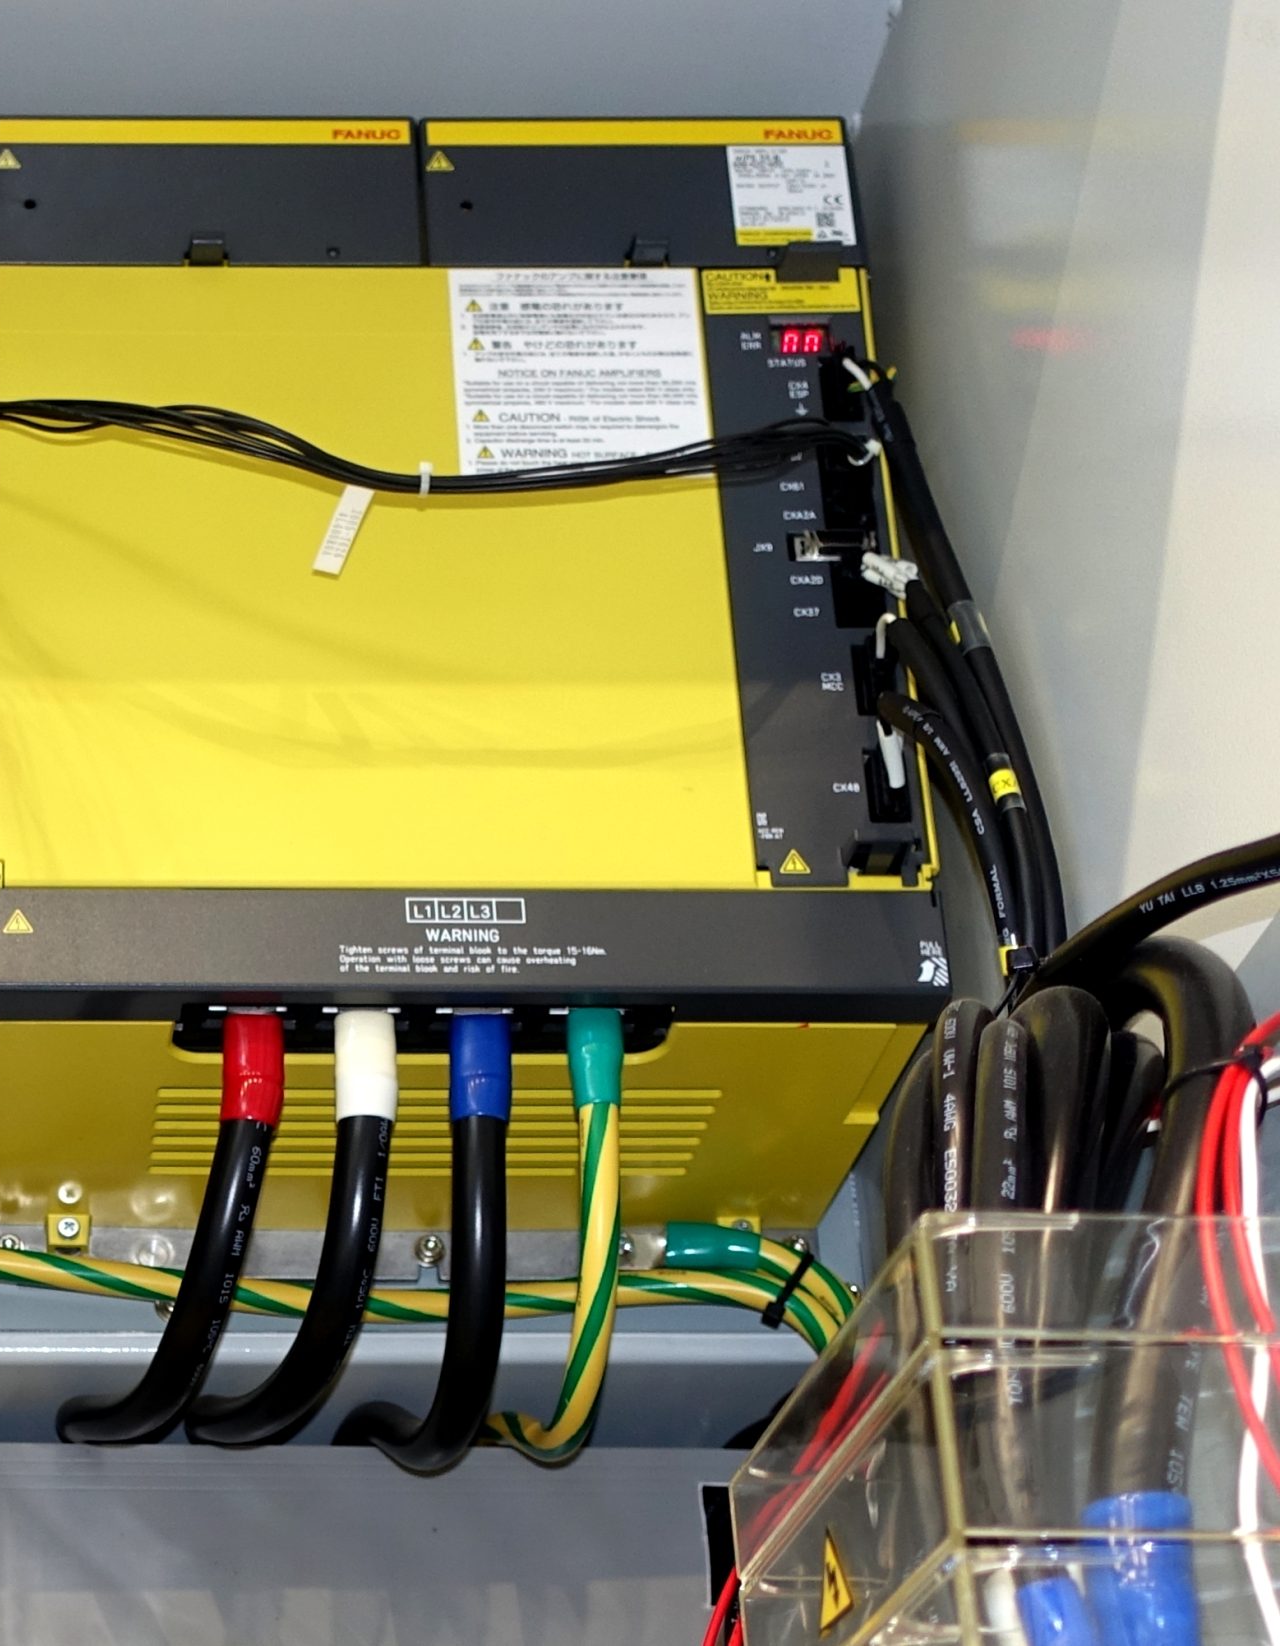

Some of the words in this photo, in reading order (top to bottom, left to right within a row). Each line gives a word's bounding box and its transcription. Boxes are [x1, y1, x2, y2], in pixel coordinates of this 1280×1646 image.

[332, 129, 401, 140] FANUC
[763, 129, 834, 140] FANUC
[740, 332, 762, 341] ALM
[741, 342, 762, 350] ERR
[767, 359, 807, 368] STATUS
[497, 369, 538, 378] NOTICE
[540, 369, 558, 378] ON
[559, 369, 596, 378] FANUC
[599, 369, 662, 378] AMPLIFIERS
[498, 413, 561, 423] CAUTION
[500, 448, 568, 459] WARNING
[783, 511, 817, 520] CXA2A
[822, 682, 844, 691] MCC
[971, 807, 985, 836] CSA
[989, 863, 1007, 919] FORMAL
[1139, 901, 1154, 914] YU
[1157, 891, 1176, 907] TAI
[1181, 881, 1205, 898] LLB
[413, 905, 432, 918] L1
[441, 905, 462, 918] L2
[470, 905, 491, 919] L3
[425, 929, 500, 942] WARNING
[339, 945, 372, 955] Tighten
[378, 945, 408, 955] screws
[414, 945, 423, 955] of
[429, 945, 464, 955] terminal
[497, 945, 507, 955] to
[513, 945, 527, 955] the
[533, 945, 561, 955] torque
[340, 955, 381, 965] Operation
[387, 955, 407, 965] with
[412, 955, 434, 965] loose
[440, 955, 471, 965] screws
[477, 955, 491, 965] can
[497, 955, 521, 965] cause
[526, 955, 576, 965] overheating
[340, 964, 349, 973] of
[355, 964, 369, 973] the
[375, 964, 410, 973] terminal
[444, 964, 458, 973] and
[463, 964, 480, 973] risk
[486, 964, 495, 973] of
[501, 964, 519, 973] fire.
[1002, 1068, 1017, 1091] 1015
[943, 1093, 957, 1132] 4AWG
[1003, 1100, 1017, 1121] AWM
[246, 1145, 263, 1188] 60mm²
[373, 1176, 385, 1202] FT1
[368, 1217, 380, 1252] 600V
[232, 1229, 245, 1257] AWM
[220, 1272, 235, 1304] 1015
